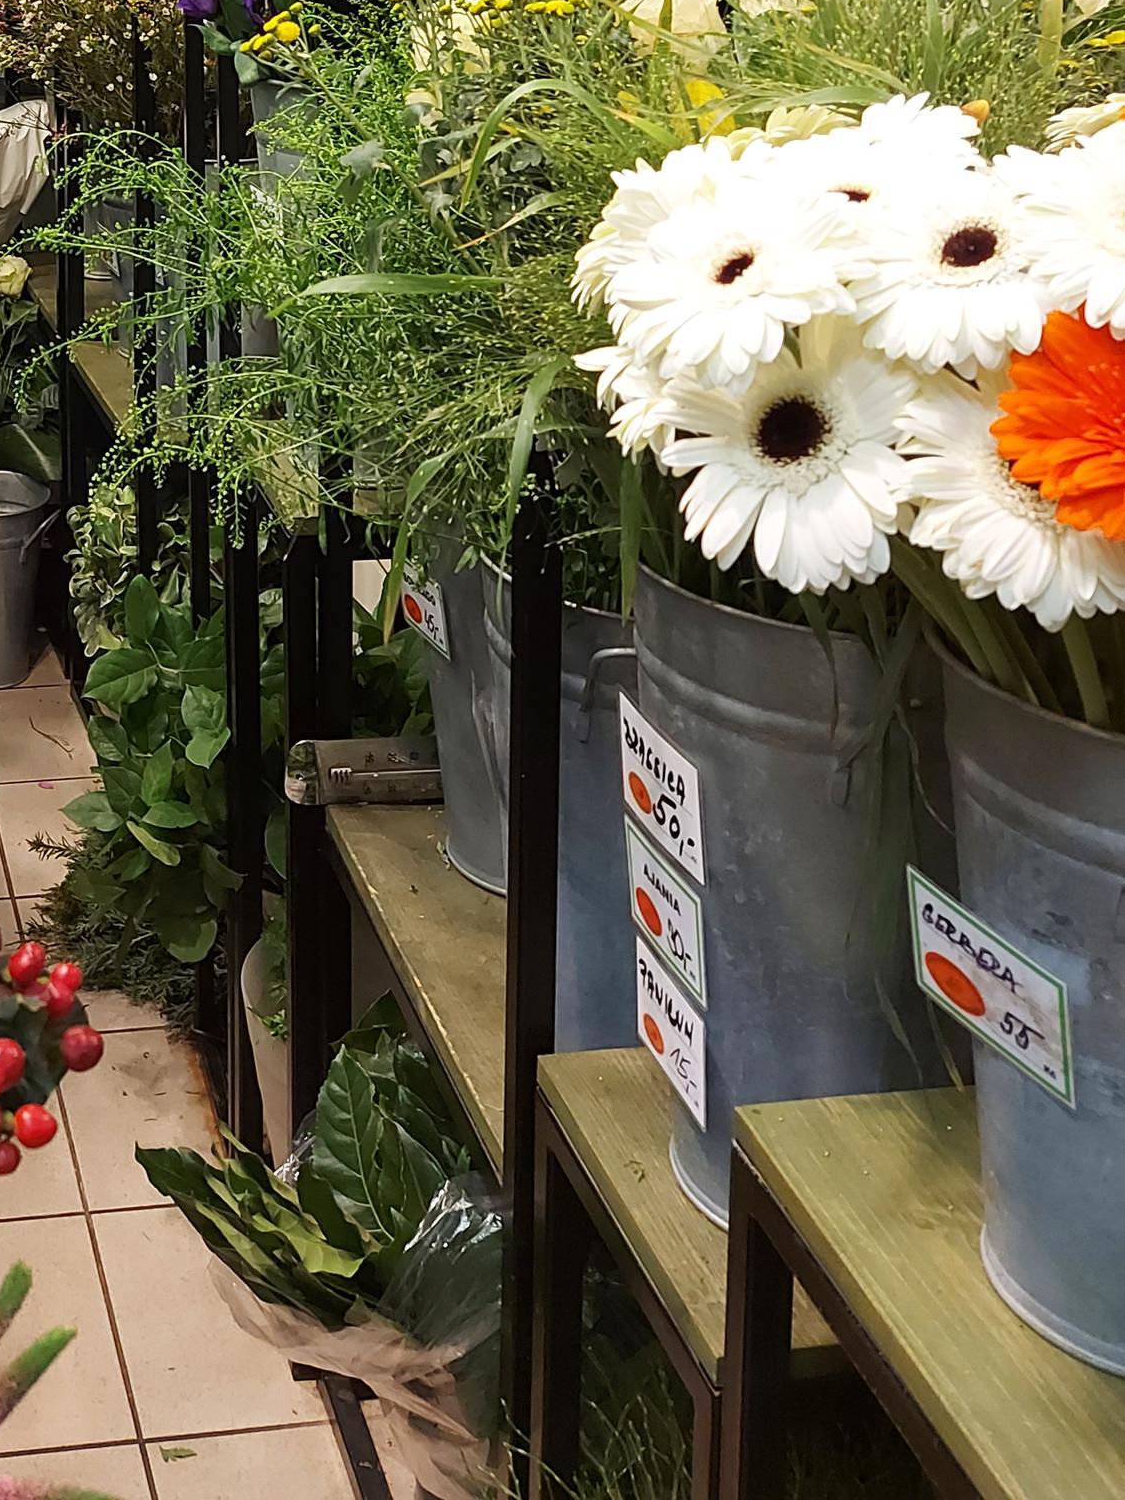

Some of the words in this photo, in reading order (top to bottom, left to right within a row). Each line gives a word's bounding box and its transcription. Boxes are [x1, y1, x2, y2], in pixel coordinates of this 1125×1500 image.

[652, 793, 696, 857] 50,-
[643, 863, 682, 917] AJANIA
[921, 903, 1023, 994] GERBERA
